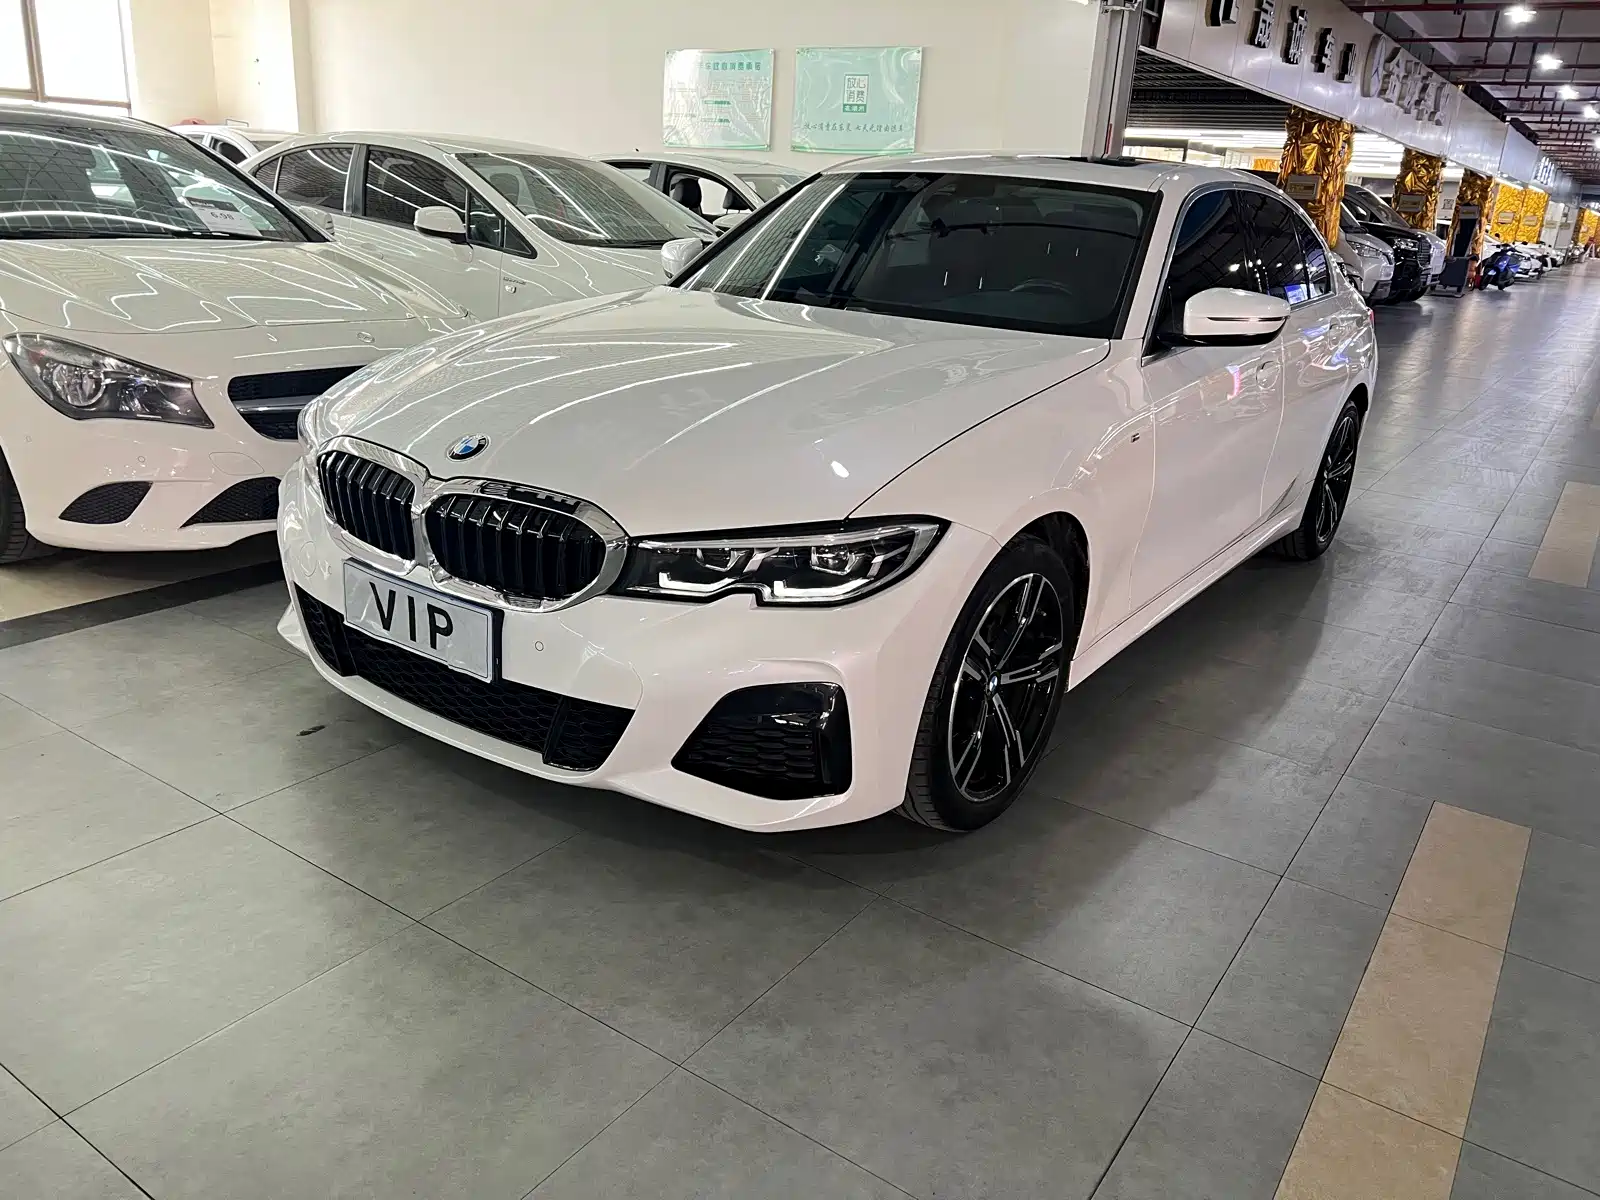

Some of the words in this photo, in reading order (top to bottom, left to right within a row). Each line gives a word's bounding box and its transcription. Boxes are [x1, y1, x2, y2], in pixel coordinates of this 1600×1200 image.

[846, 77, 866, 89] 放心
[846, 89, 865, 103] 消费
[368, 581, 454, 650] VIP
